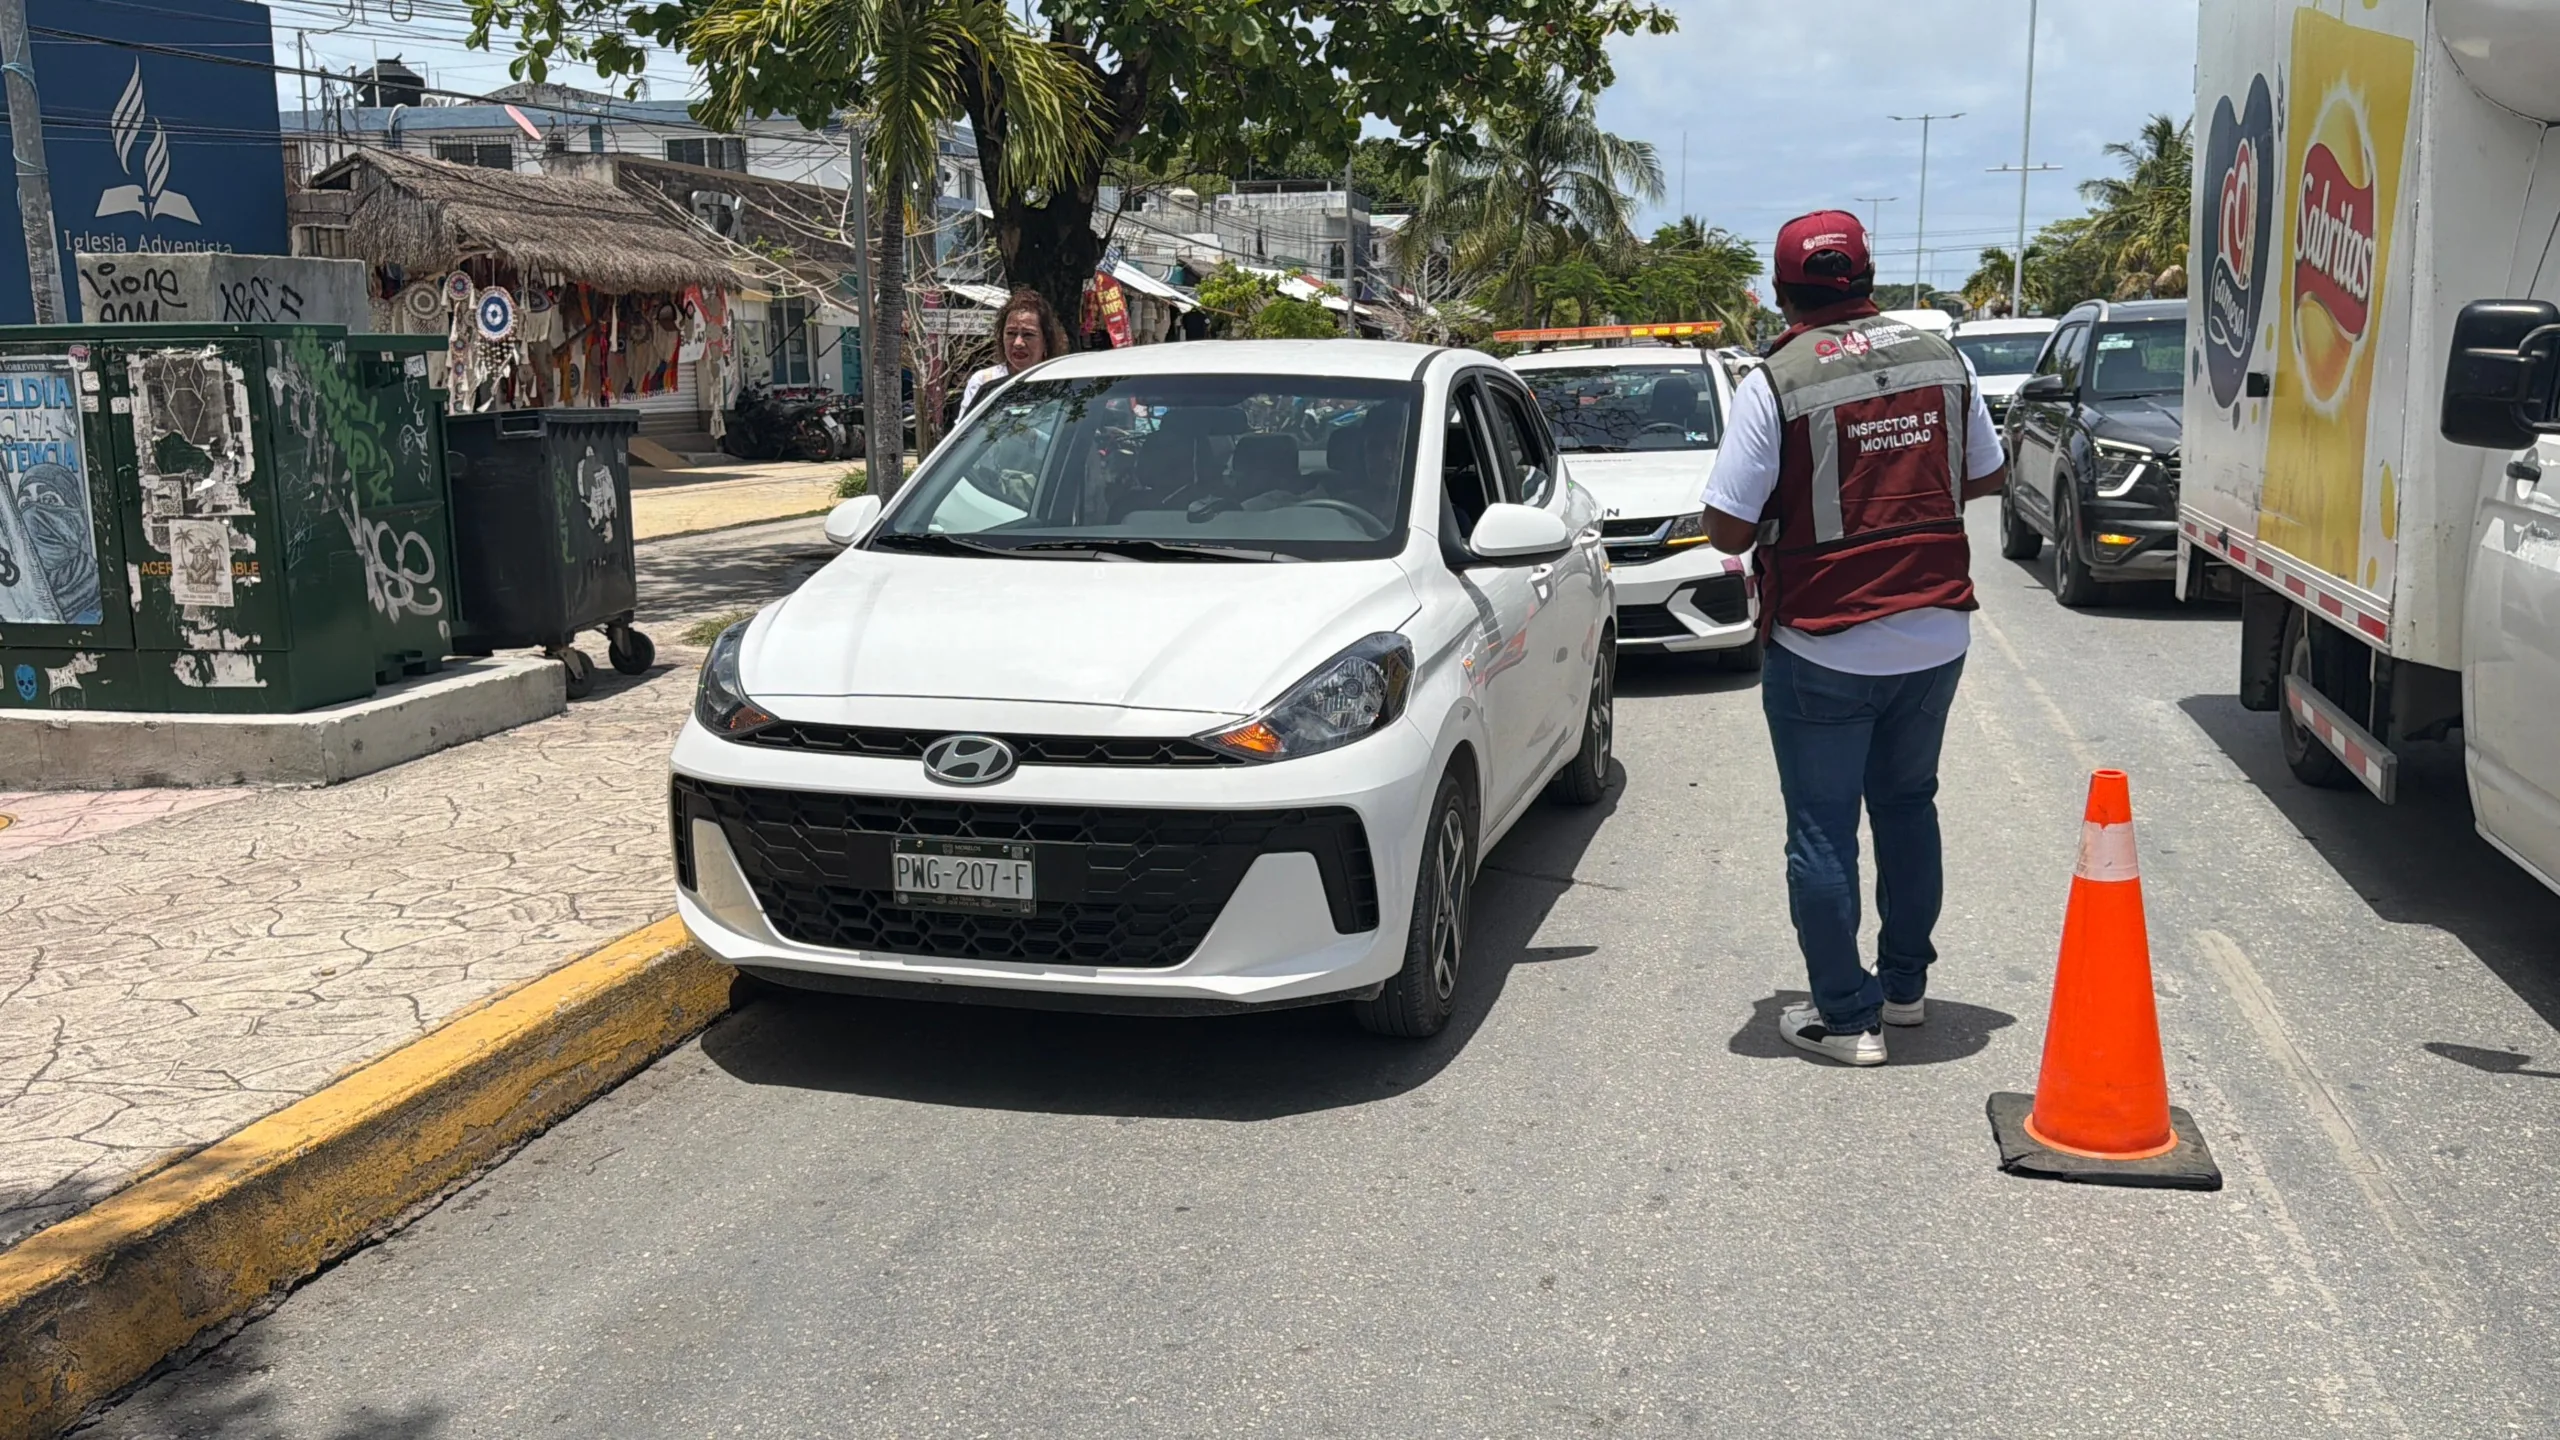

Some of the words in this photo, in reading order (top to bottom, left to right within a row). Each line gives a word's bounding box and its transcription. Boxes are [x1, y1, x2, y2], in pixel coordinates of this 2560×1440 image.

[64, 229, 127, 254] Iglesia
[138, 233, 232, 254] Adventista
[2294, 172, 2373, 302] Sabritas
[2214, 268, 2245, 338] Gamesa
[1847, 414, 1919, 439] INSPECTOR
[1923, 411, 1939, 425] DE
[1860, 428, 1932, 453] MOVILIDAD
[954, 844, 981, 852] MORELOS
[896, 855, 1028, 895] PWG-207-F
